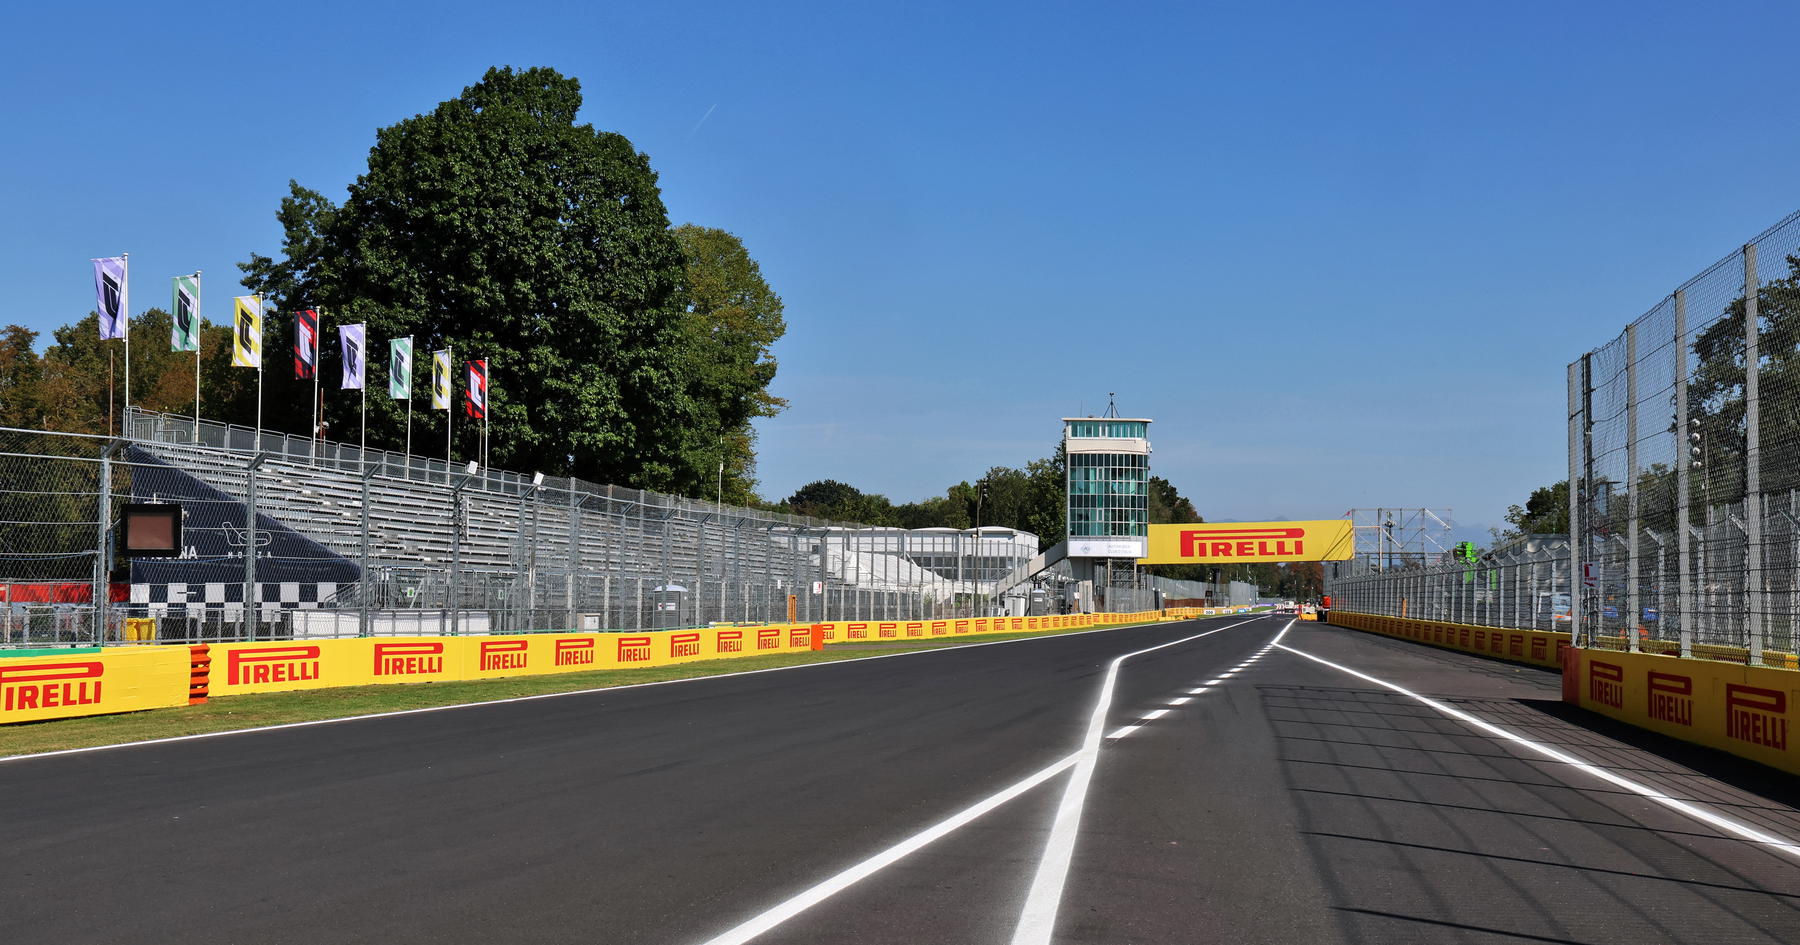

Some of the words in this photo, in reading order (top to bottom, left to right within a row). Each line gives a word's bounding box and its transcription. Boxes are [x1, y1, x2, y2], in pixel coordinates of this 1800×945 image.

[1180, 528, 1305, 557] PIRELLI
[717, 631, 743, 653] PIRELLI
[758, 629, 780, 650] PIRELLI
[790, 629, 810, 647] PIRELLI
[823, 624, 835, 640] ELLI
[848, 624, 867, 639] PIRELLI
[880, 623, 897, 638] PIRELLI
[480, 640, 528, 671] PIRELLI
[556, 638, 595, 666] PIRELLI
[618, 637, 651, 662] PIRELLI
[671, 633, 700, 657] PIRELLI
[228, 645, 320, 686] PIRELLI
[374, 642, 444, 676] PIRELLI
[1590, 660, 1623, 711] PIRELLI
[1648, 671, 1692, 727] PIRELLI
[1726, 683, 1786, 751] PIRELLI
